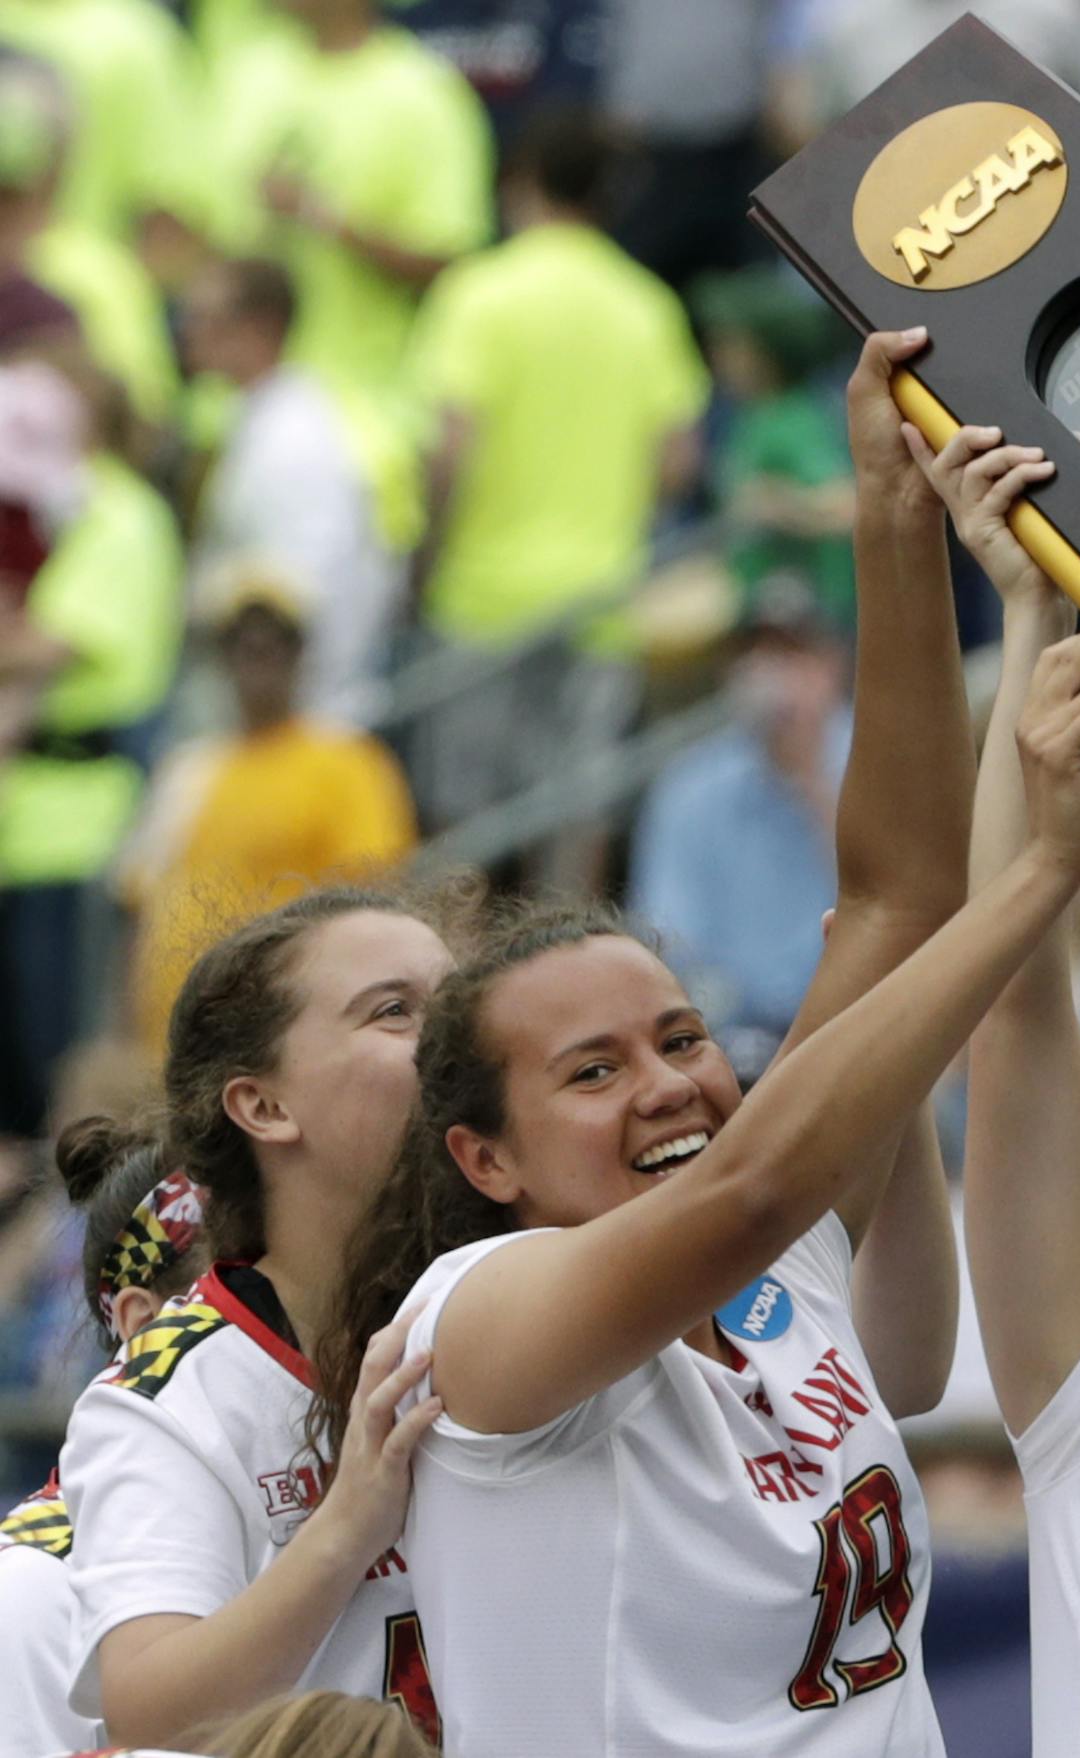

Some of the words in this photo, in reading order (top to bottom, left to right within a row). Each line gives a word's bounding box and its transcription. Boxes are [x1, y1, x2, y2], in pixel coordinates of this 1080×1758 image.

[892, 126, 1064, 284] NCAA
[742, 1282, 783, 1336] NCAA
[788, 1463, 914, 1711] 19
